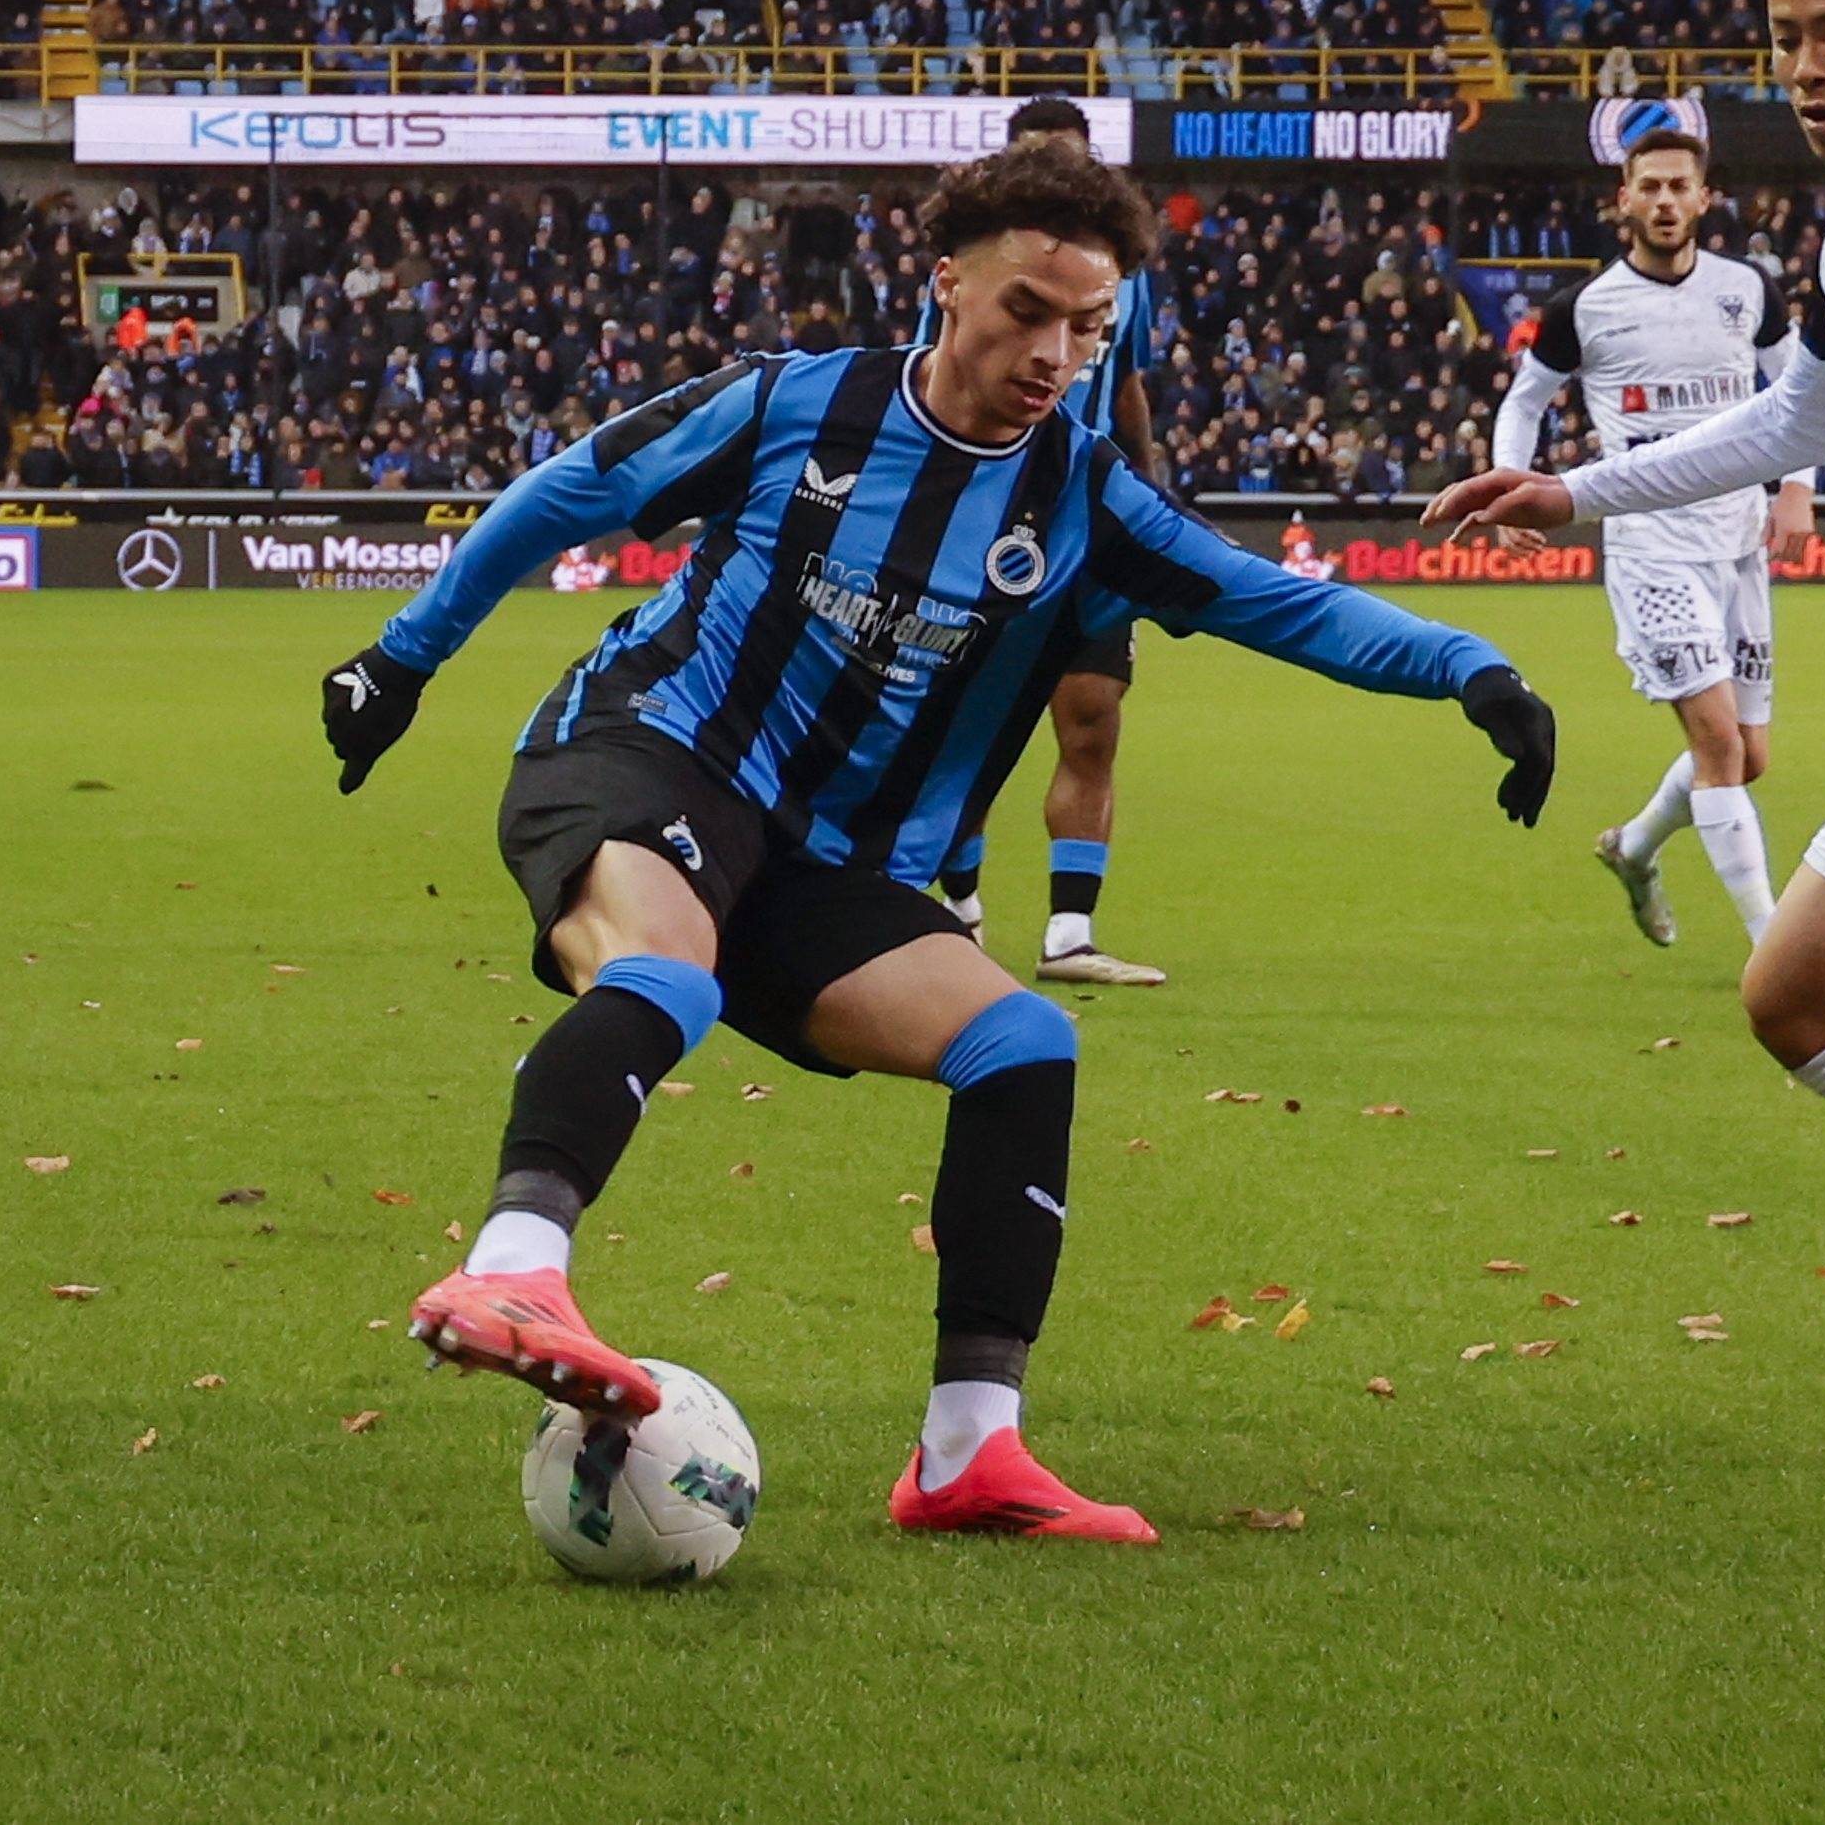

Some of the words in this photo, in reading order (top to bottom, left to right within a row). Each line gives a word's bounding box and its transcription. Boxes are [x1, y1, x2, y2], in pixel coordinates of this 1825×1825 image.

[1174, 110, 1214, 158] NO
[1219, 110, 1312, 158] HEART
[1313, 110, 1356, 159] NO
[1359, 110, 1453, 159] GLORY
[242, 535, 314, 572] Van
[323, 533, 453, 571] Mossel
